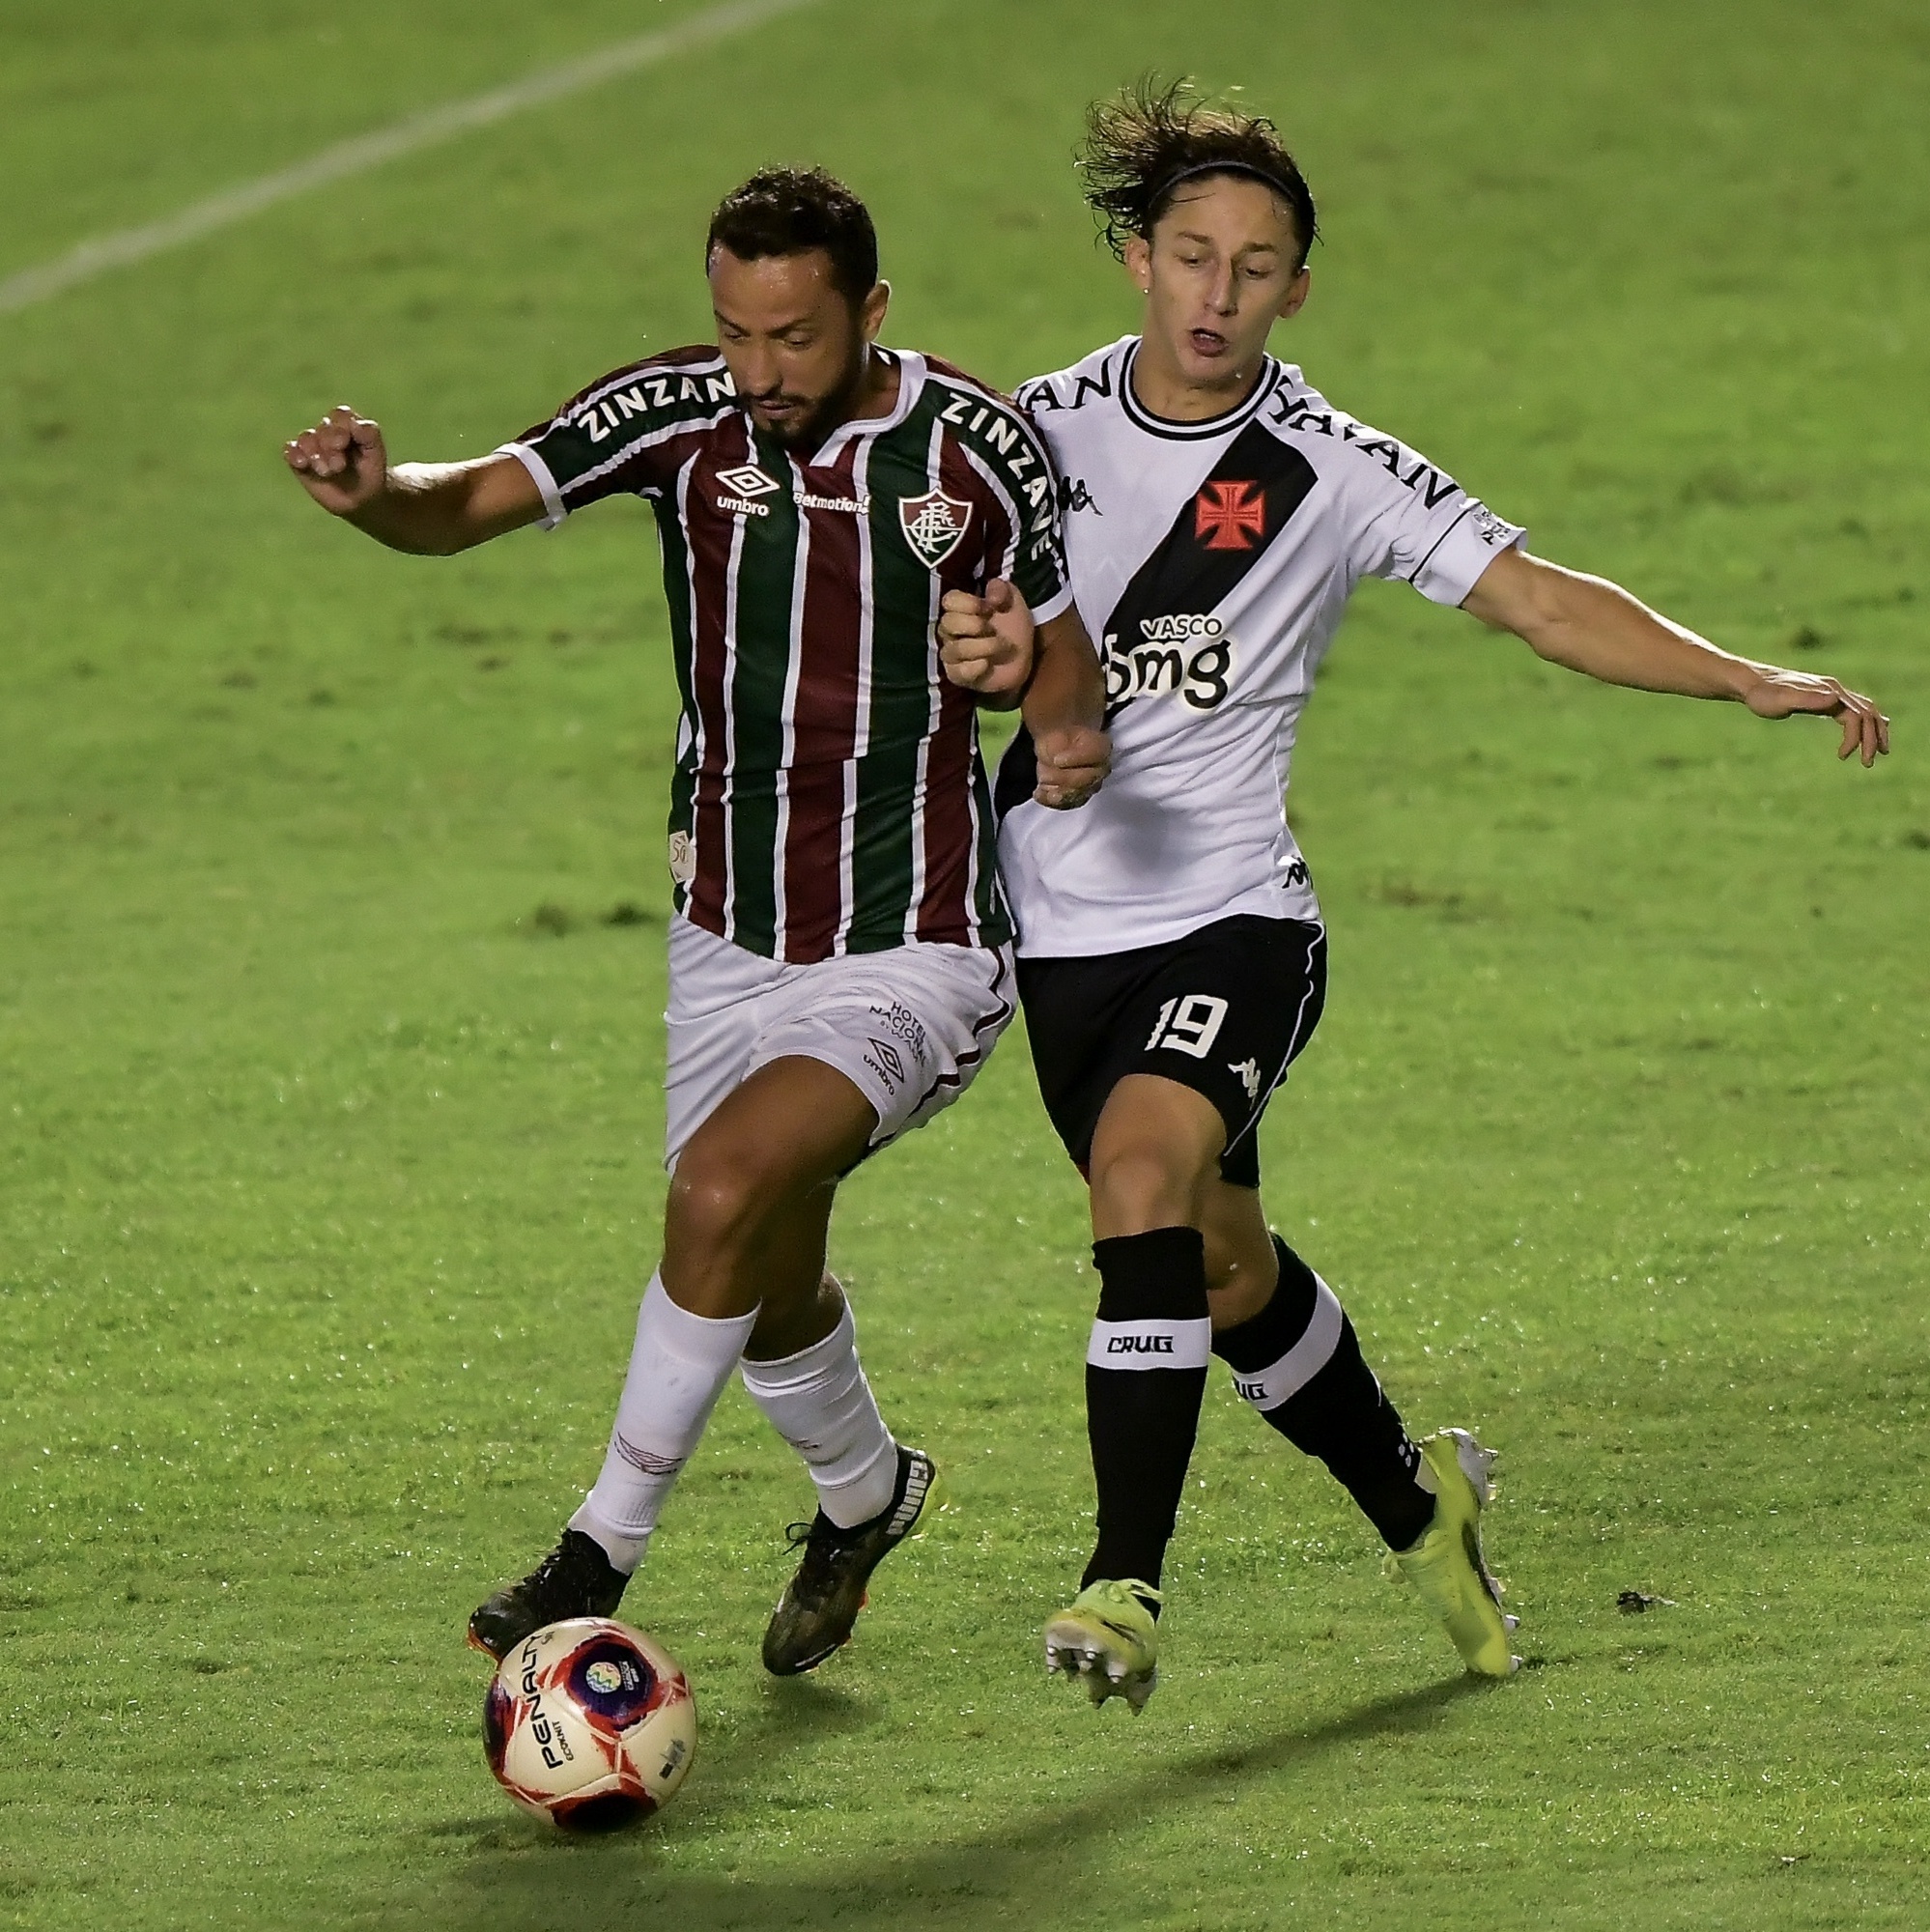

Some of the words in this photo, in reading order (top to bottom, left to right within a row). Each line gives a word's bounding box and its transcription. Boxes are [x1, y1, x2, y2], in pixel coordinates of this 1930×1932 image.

[577, 371, 738, 443] ZINZAN
[940, 391, 1053, 561] ZINZANE
[716, 495, 771, 517] umbro
[1141, 614, 1224, 639] VASCO
[891, 1001, 926, 1043] HOTEL
[1144, 994, 1229, 1059] 19
[863, 1054, 895, 1096] umbro
[1107, 1335, 1175, 1353] CRUG
[1233, 1376, 1269, 1401] UG
[522, 1634, 564, 1770] PENALTY
[552, 1719, 575, 1762] ECOKNIT
